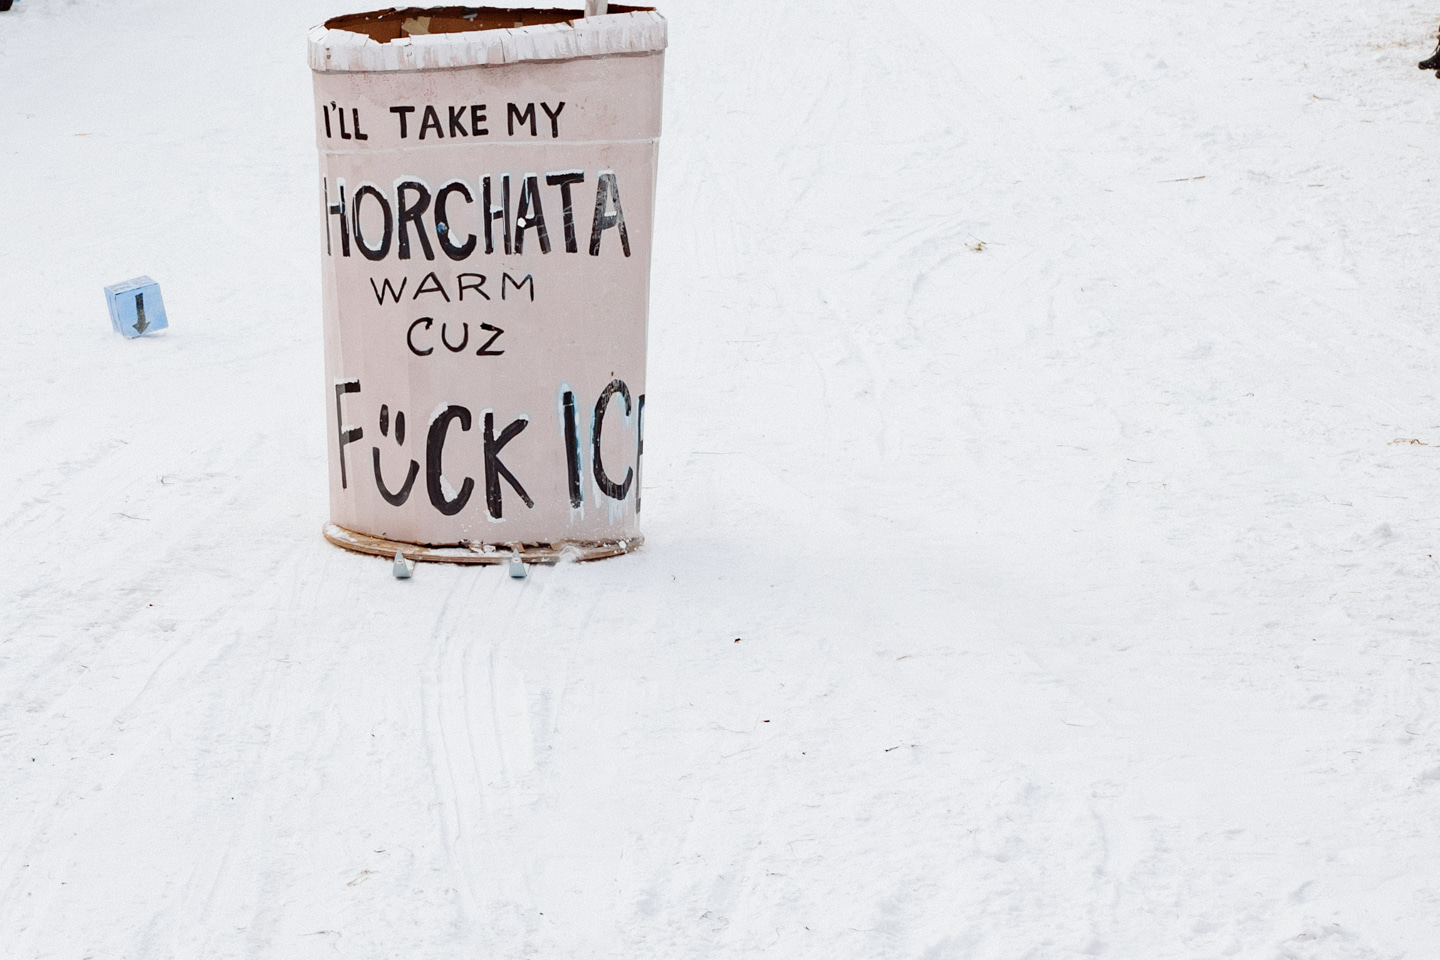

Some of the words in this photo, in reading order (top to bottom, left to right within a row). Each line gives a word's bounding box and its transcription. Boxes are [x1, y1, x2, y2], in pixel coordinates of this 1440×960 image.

[323, 101, 369, 141] I'LL
[389, 103, 490, 140] TAKE
[506, 100, 566, 139] MY
[322, 171, 632, 262] HORCHATA
[369, 271, 535, 306] WARM
[406, 316, 506, 357] CUZ
